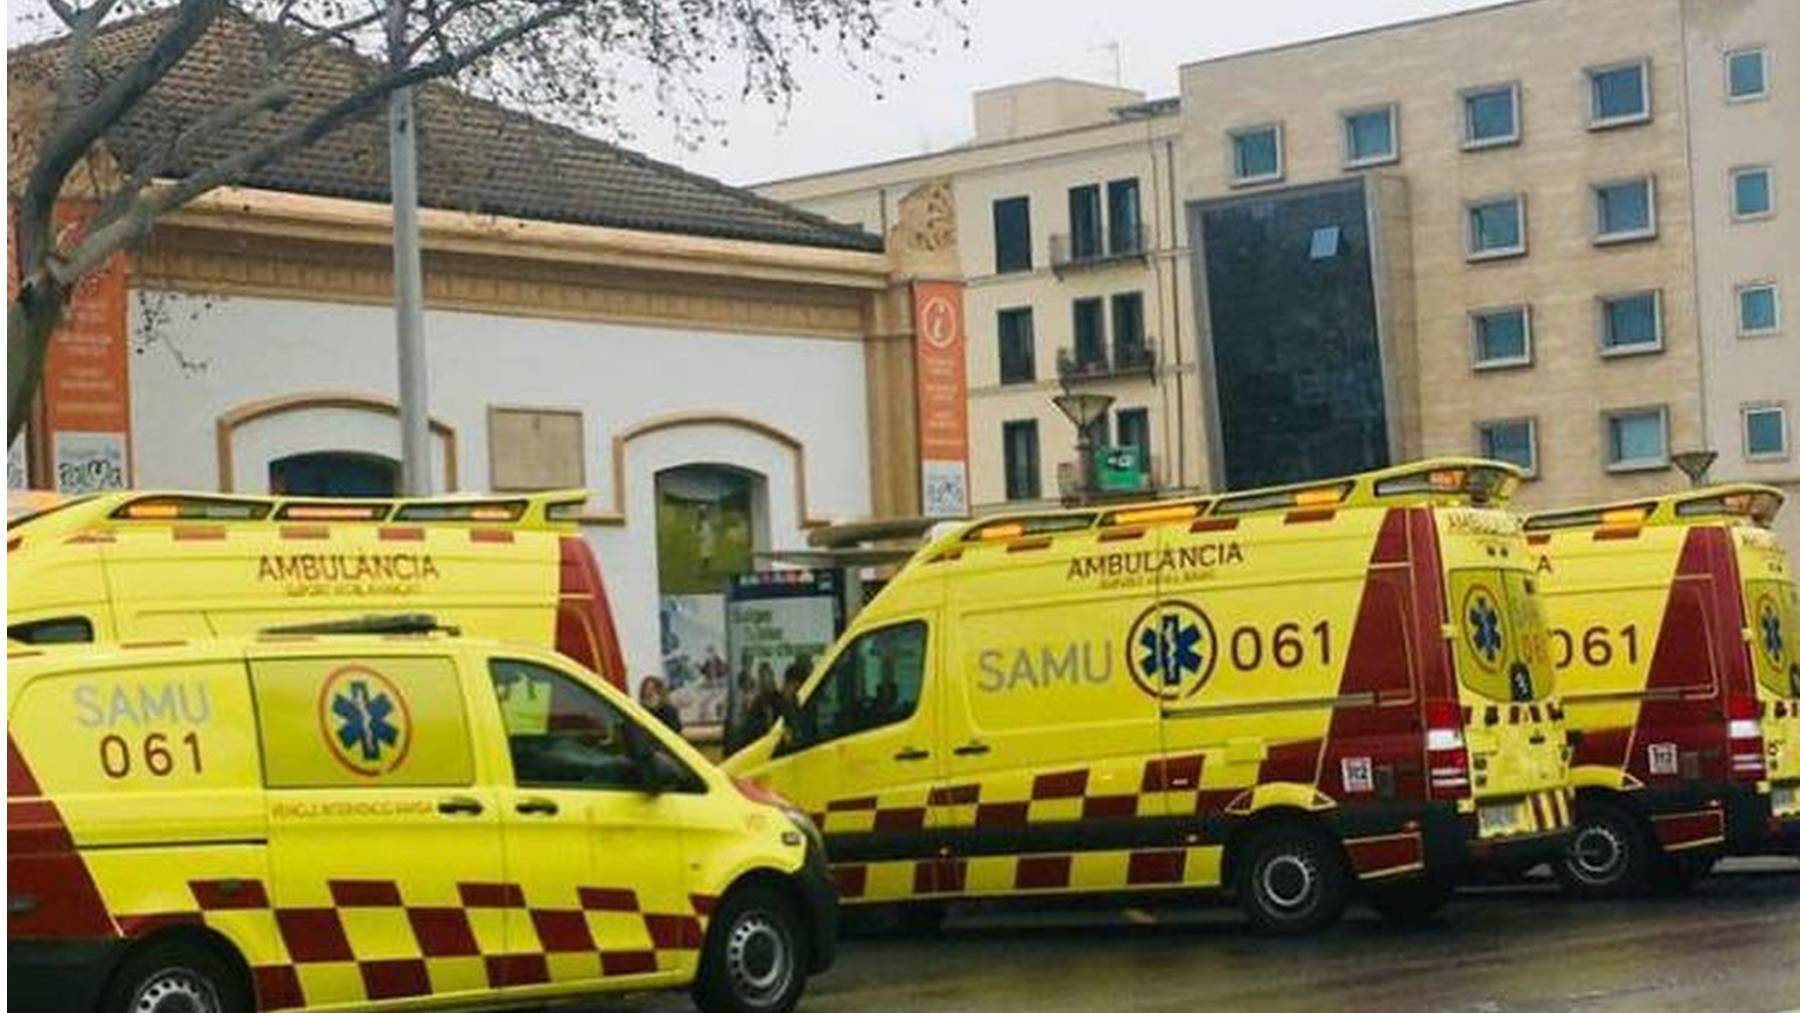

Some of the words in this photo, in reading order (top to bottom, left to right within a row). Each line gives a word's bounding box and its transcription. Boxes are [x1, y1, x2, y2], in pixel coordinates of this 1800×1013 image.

[977, 637, 1113, 693] SAMU
[1230, 620, 1331, 672] 061
[73, 681, 212, 728] SAMU
[100, 731, 204, 779] 061
